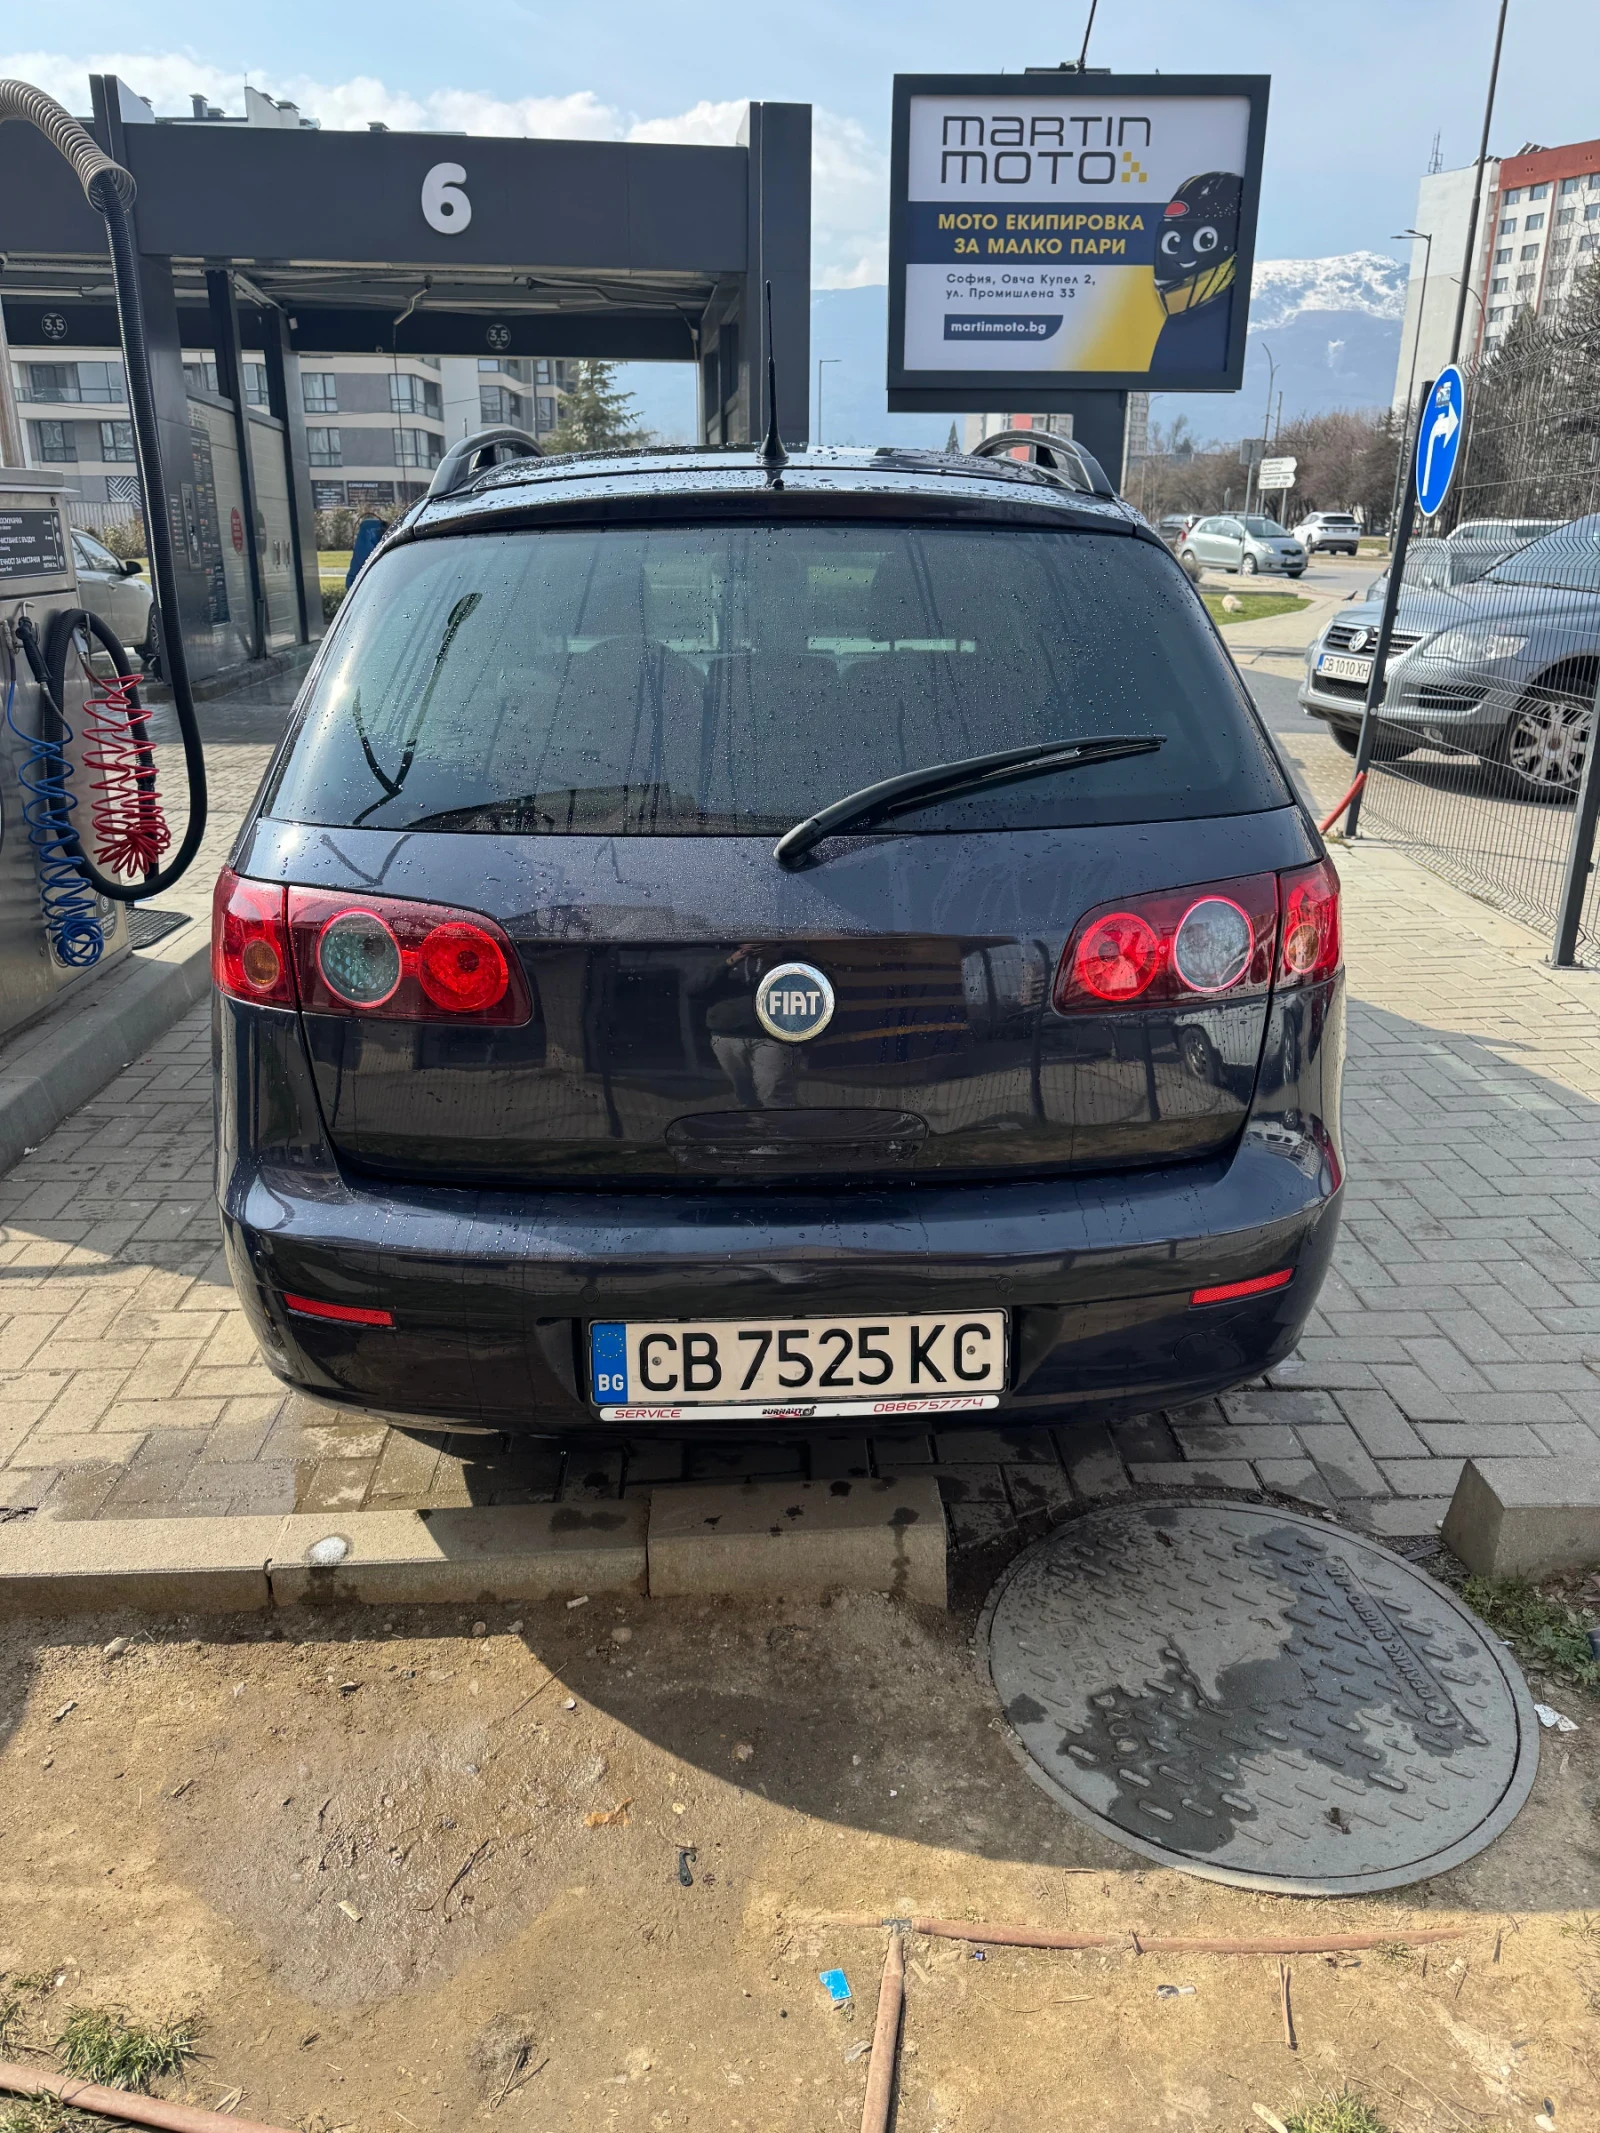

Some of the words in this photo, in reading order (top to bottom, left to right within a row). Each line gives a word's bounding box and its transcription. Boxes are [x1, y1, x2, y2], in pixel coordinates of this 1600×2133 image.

[940, 151, 1116, 184] MOTO
[421, 162, 472, 234] 6
[938, 213, 998, 231] МОТО
[1005, 214, 1145, 231] ЕКИПИРОВКА
[953, 237, 980, 254] ЗА
[987, 238, 1063, 254] МАЛКО
[1070, 238, 1126, 255] ПАРИ
[946, 273, 996, 286] София,
[1001, 274, 1035, 285] Овча
[1040, 274, 1079, 286] Купел
[1083, 274, 1096, 286] 2,
[945, 289, 963, 300] ул.
[969, 288, 1054, 300] Промишлена
[1059, 288, 1076, 298] 33
[44, 318, 65, 331] 3.5
[950, 321, 1047, 335] martinmoto.bg
[489, 329, 509, 341] 3.5
[769, 991, 820, 1015] FIAT
[639, 1332, 722, 1392] CB
[738, 1327, 894, 1391] 7525
[911, 1324, 991, 1384] KC
[597, 1373, 624, 1392] BG
[614, 1409, 682, 1418] SERVICE
[873, 1398, 984, 1413] 0886757774
